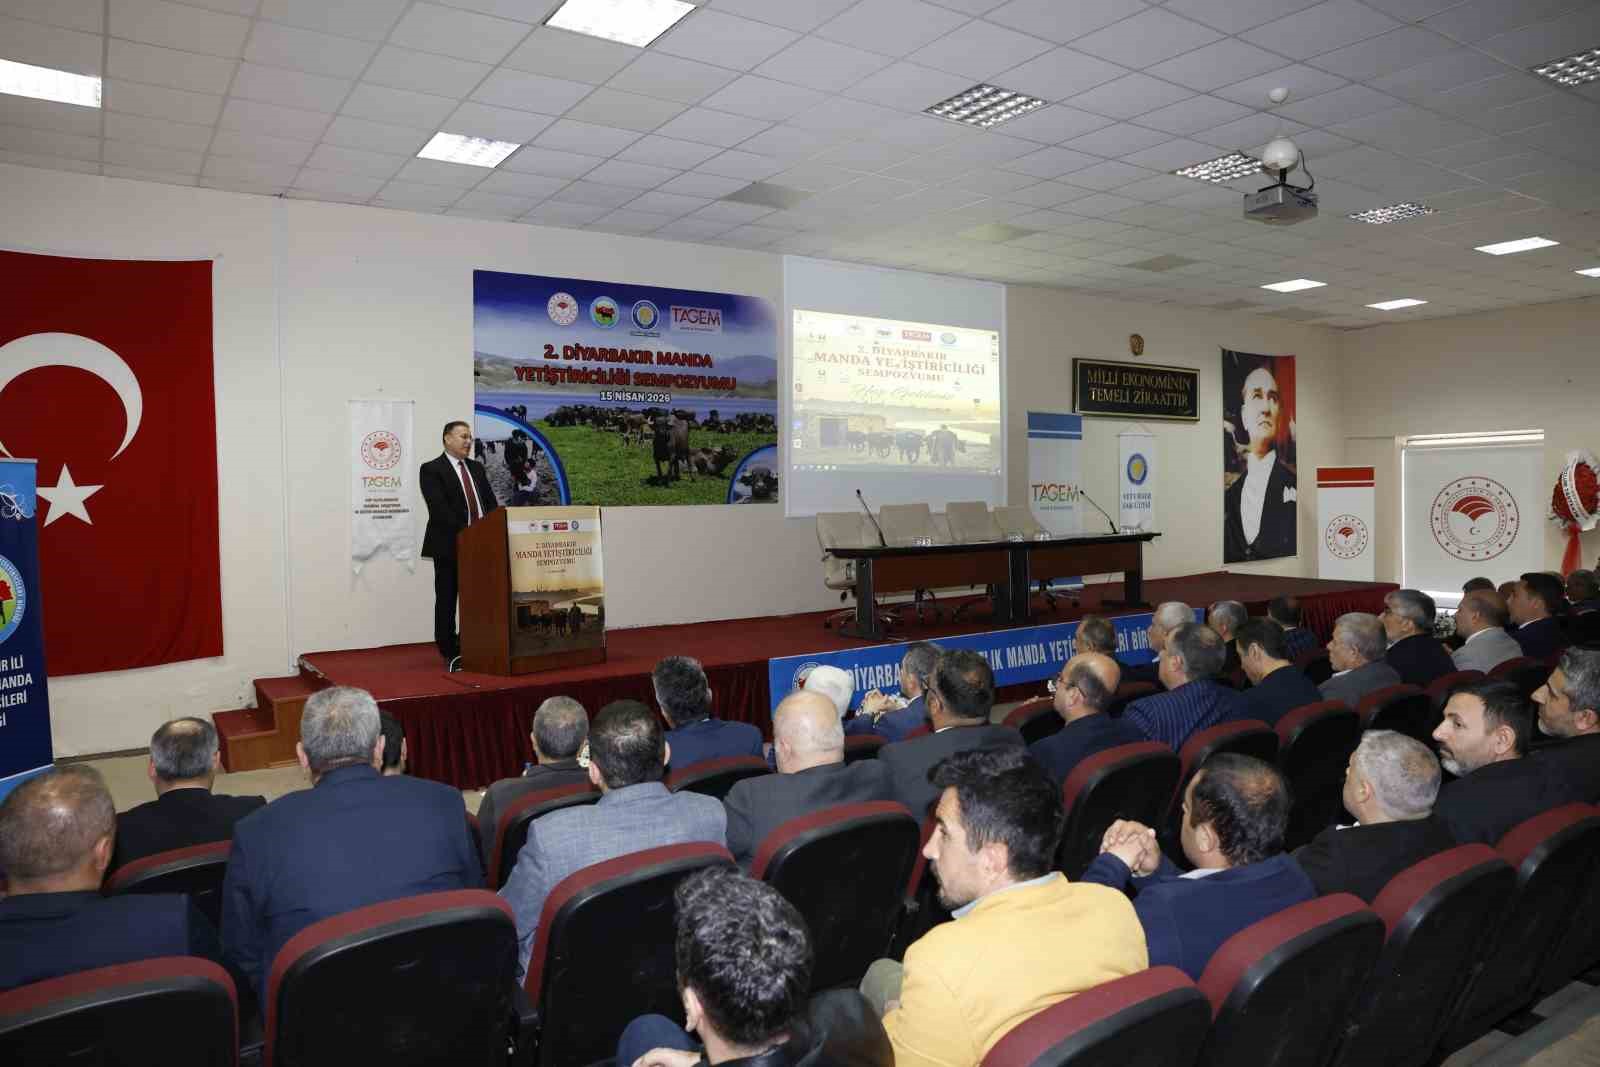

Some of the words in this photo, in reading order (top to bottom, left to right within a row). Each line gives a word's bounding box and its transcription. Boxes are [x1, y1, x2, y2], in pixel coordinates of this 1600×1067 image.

[672, 307, 721, 326] TAGEM
[543, 344, 560, 360] 2.
[563, 343, 653, 364] DİYARBAKIR
[656, 351, 713, 368] MANDA
[814, 352, 870, 366] MANDA
[633, 371, 737, 391] SEMPOZYUMU
[600, 391, 613, 401] 15
[614, 391, 646, 402] NİSAN
[1032, 484, 1080, 502] TAGEM
[846, 663, 902, 691] DİYARBA
[1006, 643, 1046, 669] MANDA
[0, 672, 33, 690] ANDA
